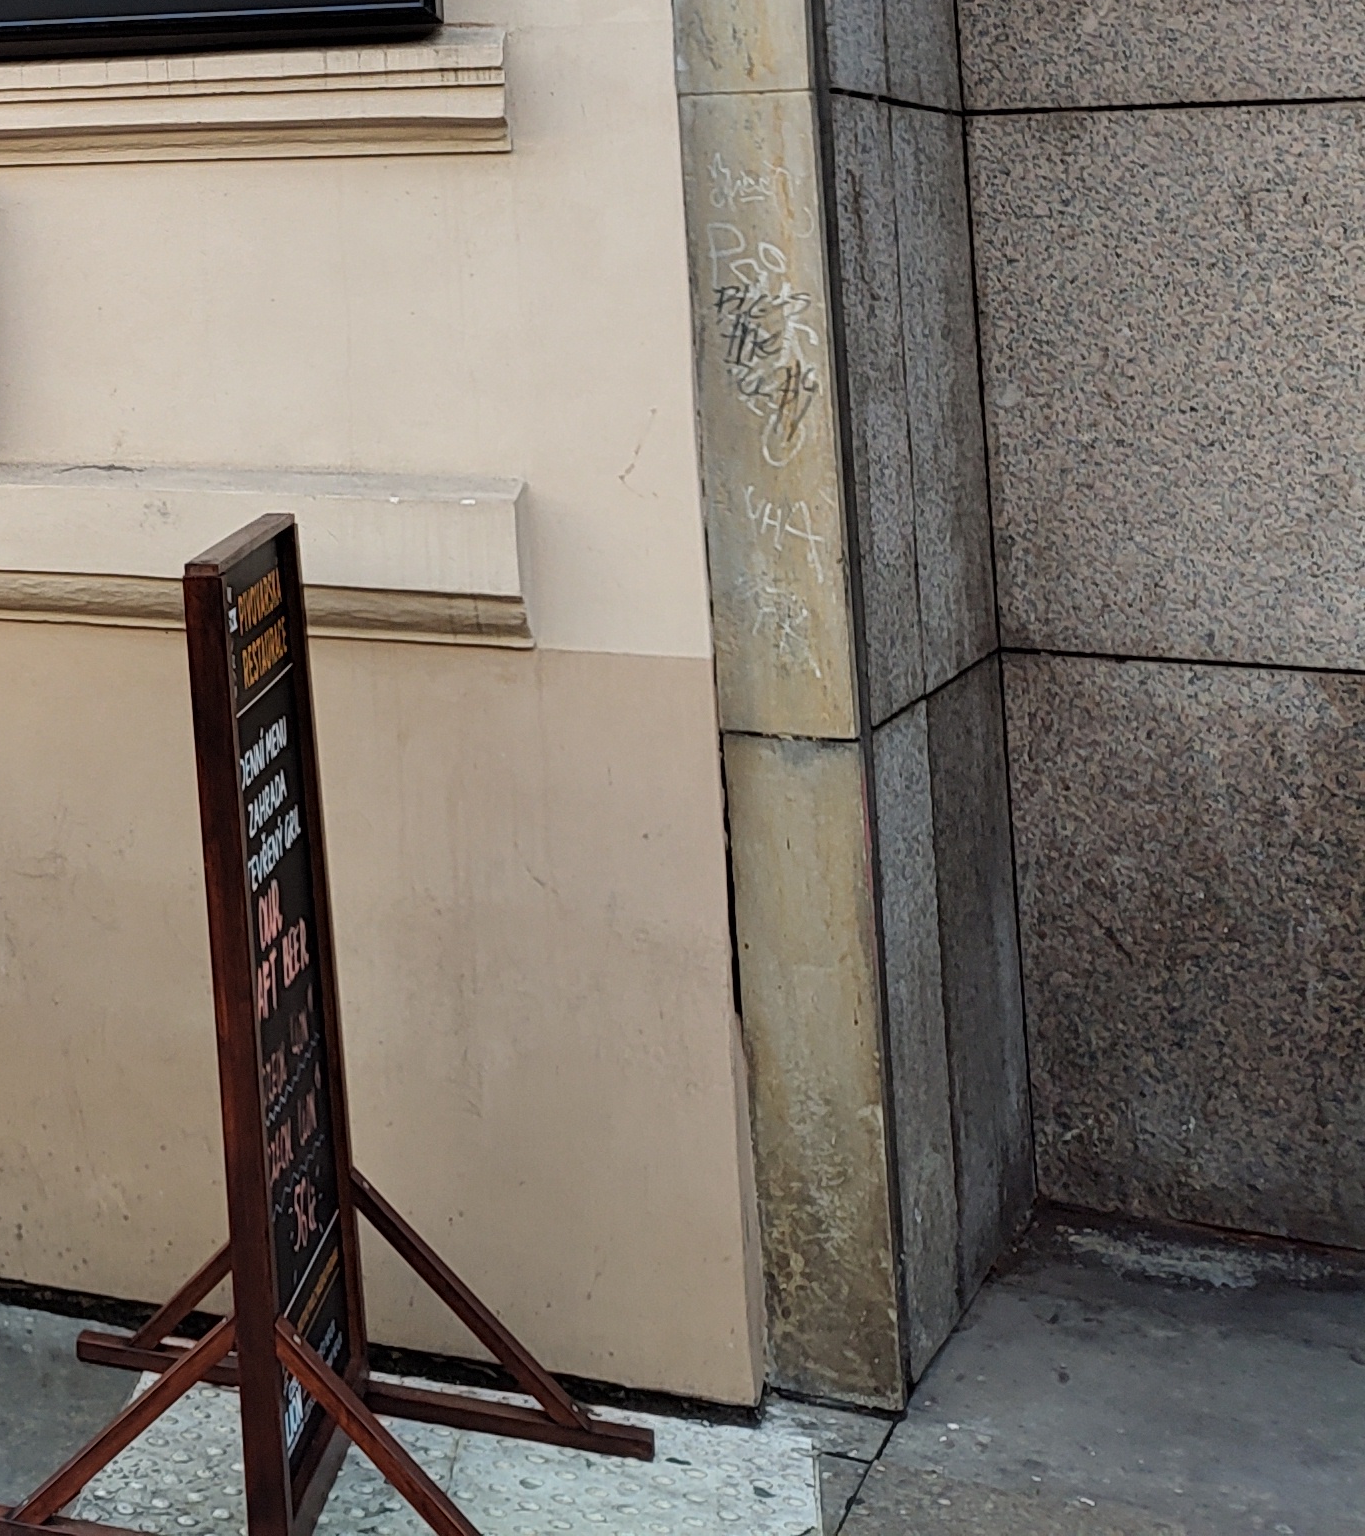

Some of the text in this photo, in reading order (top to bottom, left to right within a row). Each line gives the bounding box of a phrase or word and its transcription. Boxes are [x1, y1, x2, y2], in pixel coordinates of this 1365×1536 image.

[266, 715, 287, 764] MENU
[248, 768, 288, 839] ZAHRADA
[248, 804, 301, 892] TEVŘENÝ GRIL
[257, 946, 277, 1021] AFT
